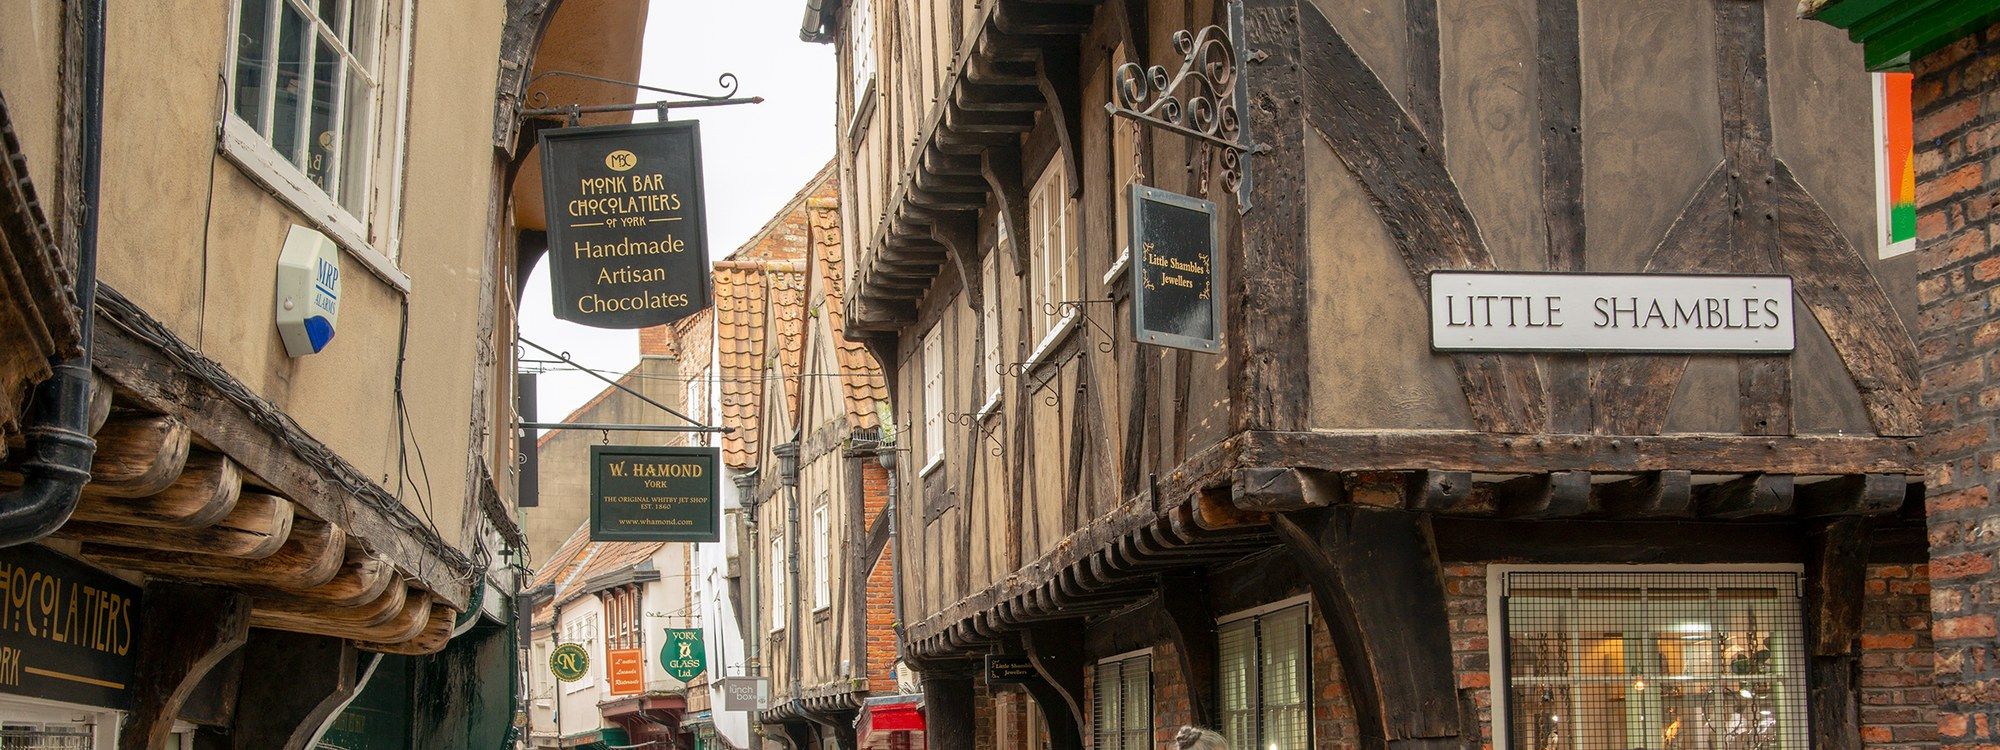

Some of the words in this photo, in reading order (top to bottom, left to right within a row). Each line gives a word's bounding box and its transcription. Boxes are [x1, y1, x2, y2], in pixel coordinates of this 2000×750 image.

[581, 176, 627, 195] MONK
[633, 174, 664, 192] BAR
[569, 194, 681, 216] CHOCOLATIERS
[620, 216, 646, 228] YORK
[574, 234, 684, 258] Handmade
[316, 257, 338, 290] MRP
[1149, 253, 1169, 267] Little
[1170, 257, 1204, 274] Shambles
[597, 265, 665, 284] Artisan
[1161, 272, 1193, 288] Jewellers
[314, 293, 336, 315] ALARMS
[578, 290, 688, 313] Chocolates
[1446, 295, 1564, 327] LITTLE
[1593, 296, 1779, 329] SHAMBLES
[609, 460, 628, 476] W.
[633, 463, 702, 478] HAMOND
[644, 480, 667, 489] YORK
[672, 631, 698, 641] YORK
[0, 646, 21, 686] RK
[670, 659, 700, 668] GLASS
[729, 685, 754, 694] lunch
[736, 693, 753, 701] box
